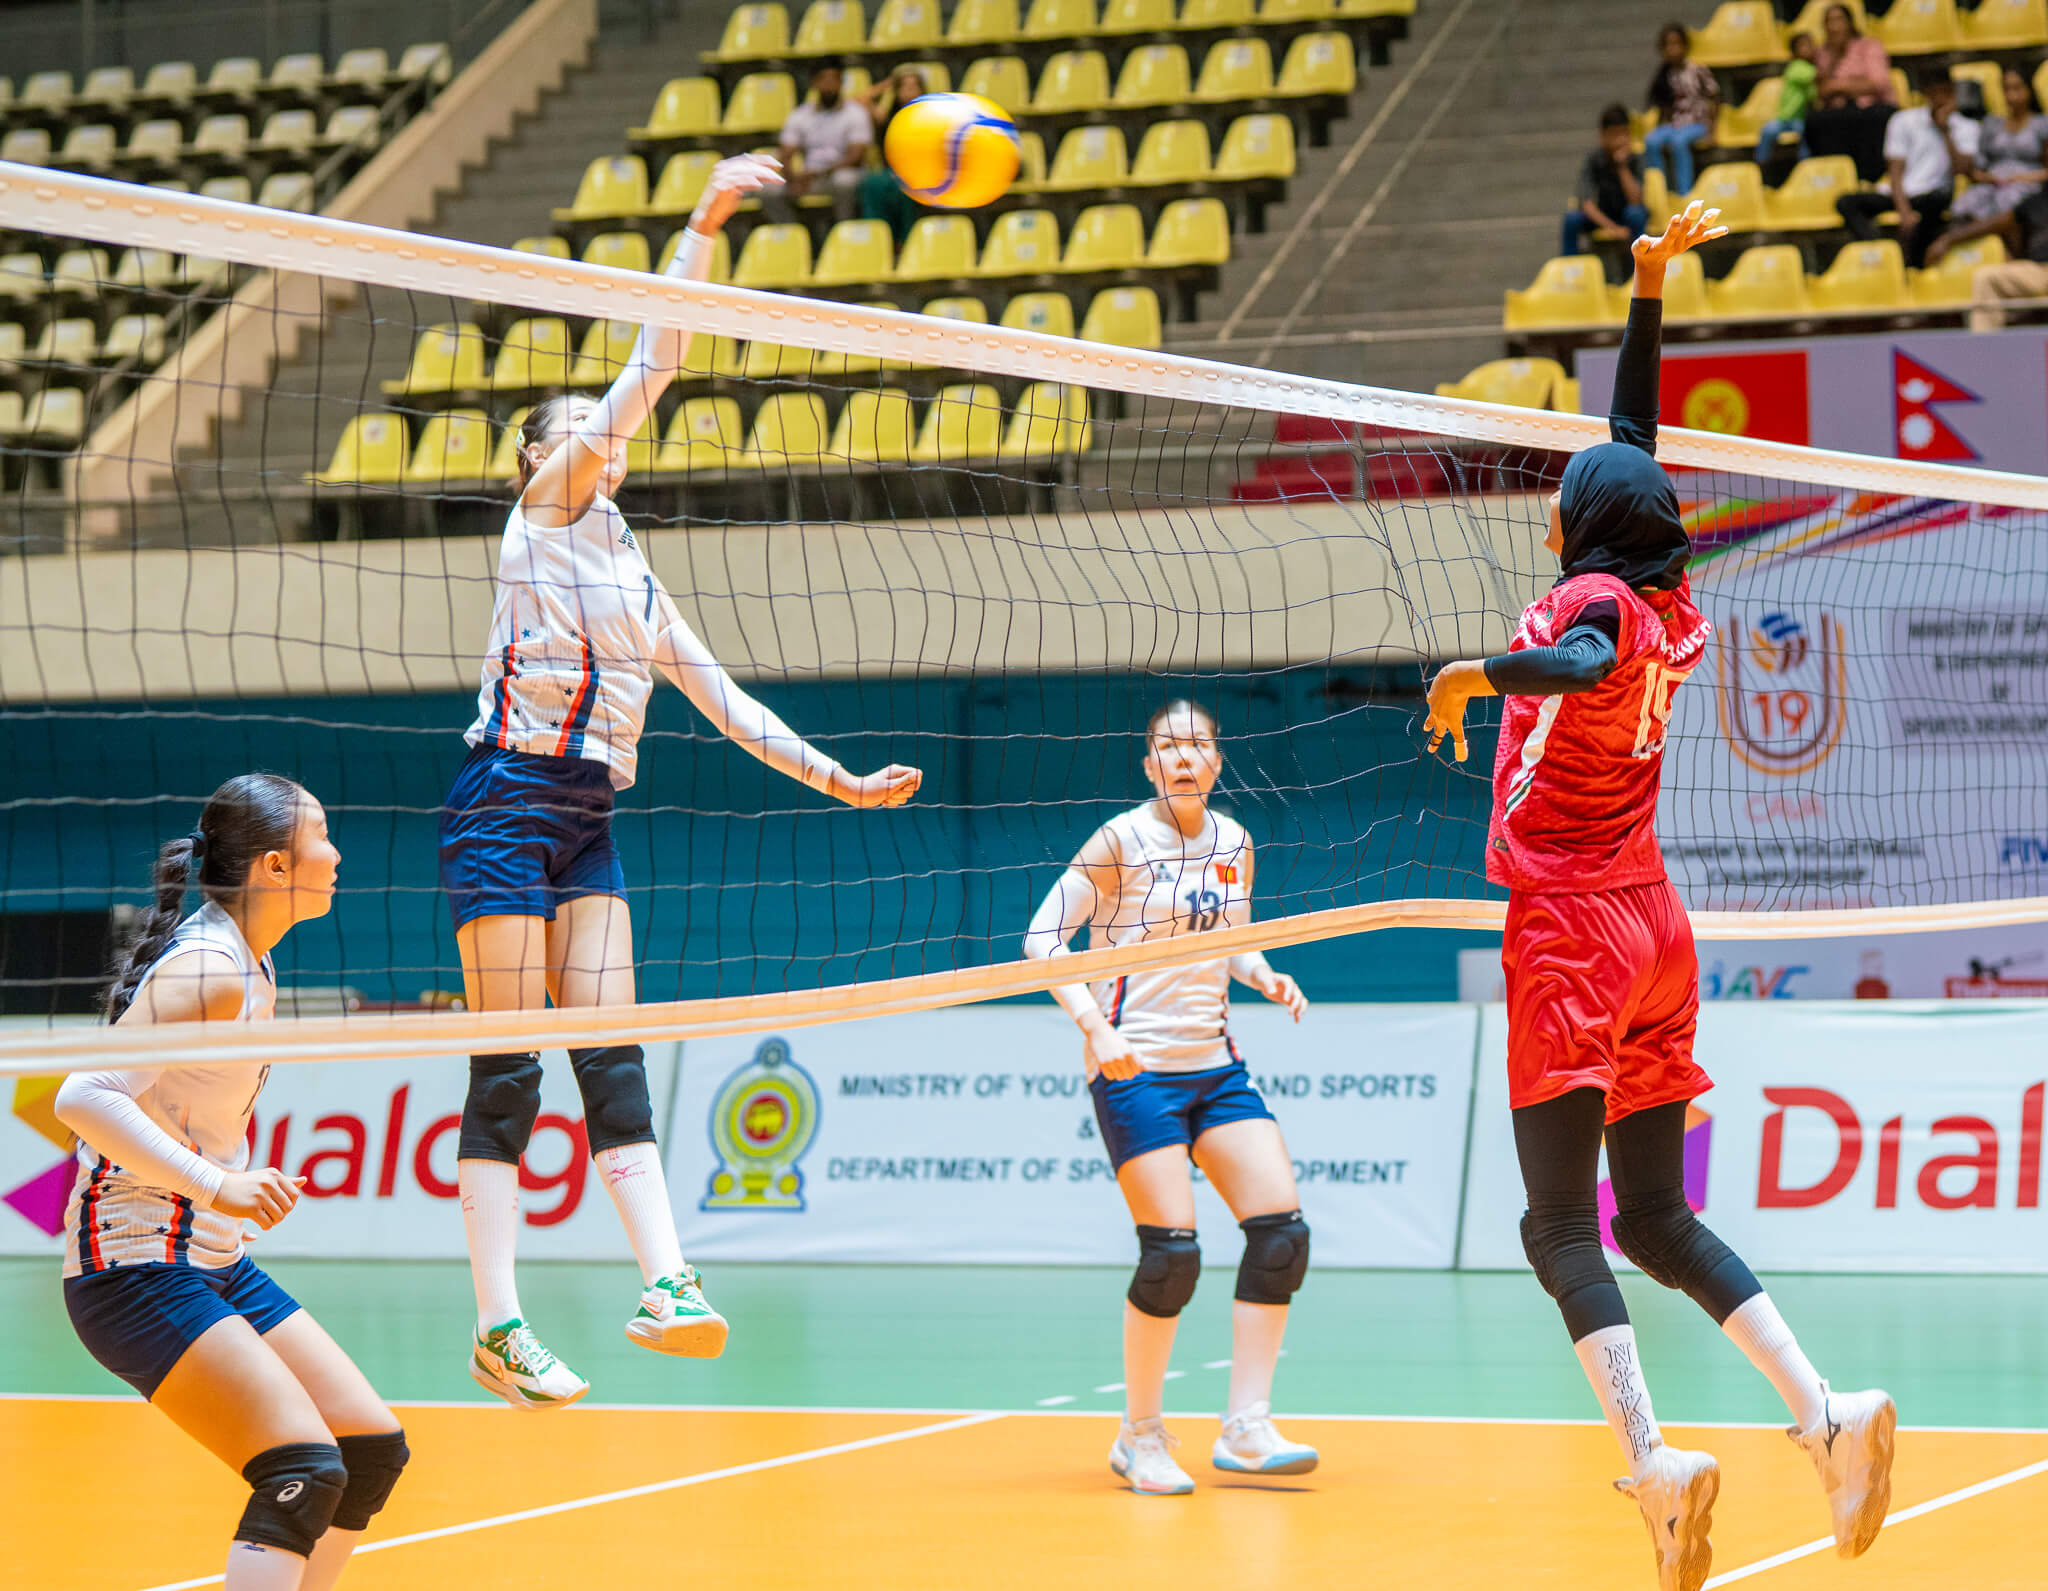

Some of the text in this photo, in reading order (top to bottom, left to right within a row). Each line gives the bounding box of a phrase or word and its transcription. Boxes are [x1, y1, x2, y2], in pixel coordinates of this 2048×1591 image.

[1751, 689, 1810, 737] 19
[1185, 890, 1220, 932] 13
[1727, 965, 1811, 999] AVC
[838, 1074, 966, 1098] MINISTRY
[973, 1074, 1011, 1098] OF
[1259, 1074, 1311, 1098] AND
[1319, 1073, 1437, 1099] SPORTS
[1077, 1116, 1096, 1139] &
[246, 1082, 590, 1227] ialog
[826, 1157, 1014, 1182] DEPARTMENT
[1020, 1158, 1058, 1182] OF
[1604, 1343, 1652, 1462] NIKE
